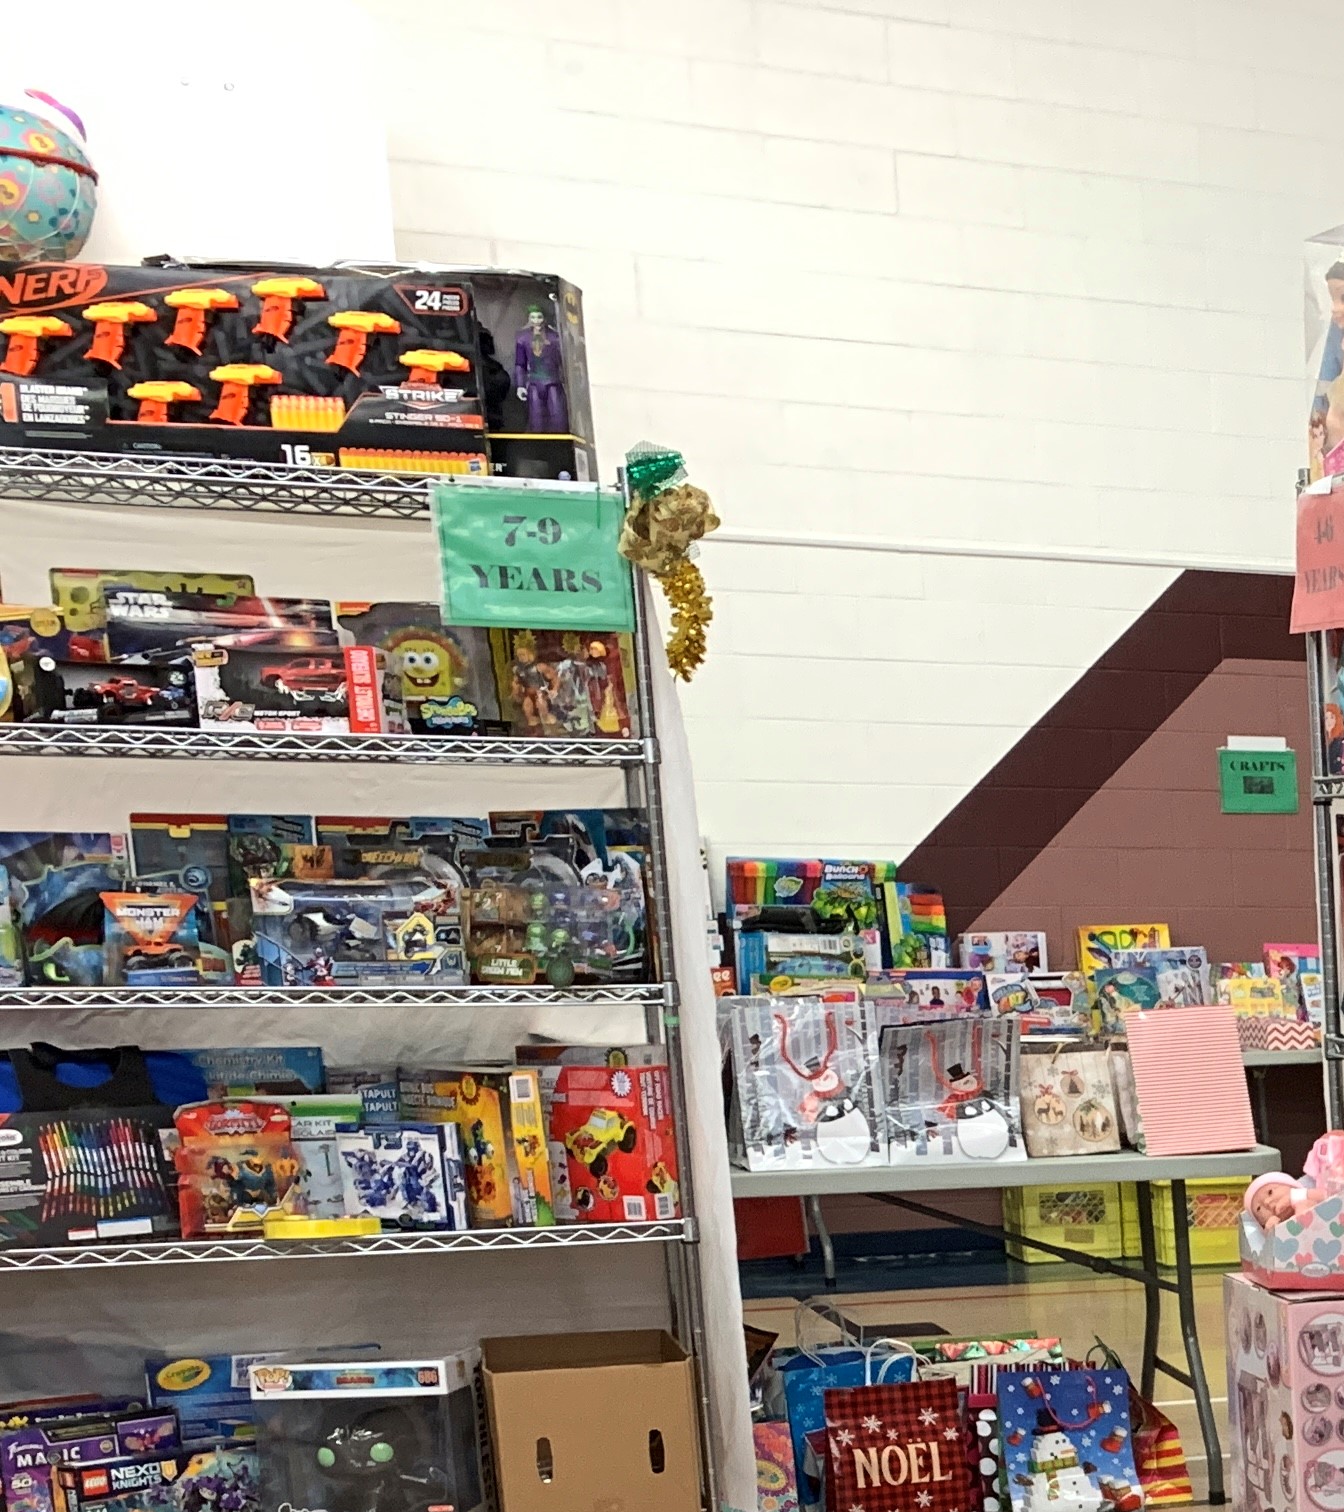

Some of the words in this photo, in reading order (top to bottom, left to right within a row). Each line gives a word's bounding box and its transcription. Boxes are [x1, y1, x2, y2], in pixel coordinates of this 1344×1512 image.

[0, 267, 104, 304] NERF
[415, 290, 443, 311] 24
[385, 389, 460, 403] STRIKE
[502, 515, 563, 548] 7-9
[470, 564, 604, 594] YEARS
[115, 592, 172, 606] STAR
[110, 605, 171, 619] WARS
[1229, 760, 1286, 772] CRAFTS
[115, 906, 181, 918] MONSTER
[136, 917, 164, 931] JAM
[853, 1437, 954, 1490] NOËL
[111, 1463, 161, 1480] NEXO
[112, 1474, 163, 1489] KNIGHTS
